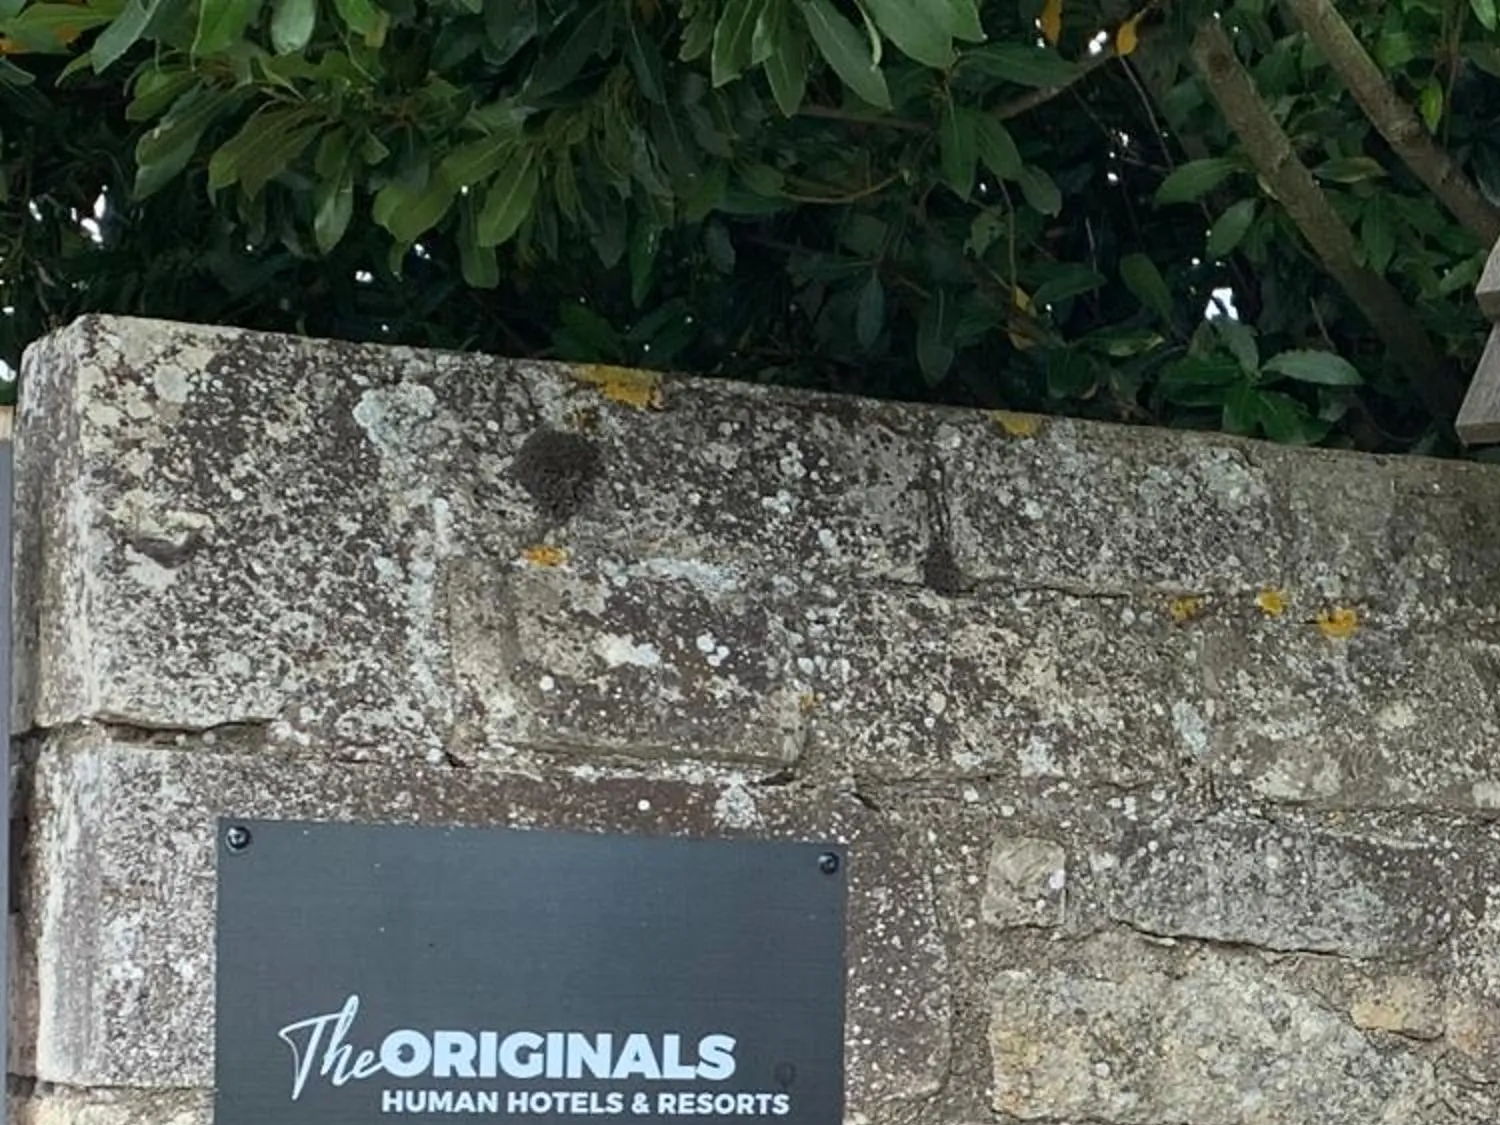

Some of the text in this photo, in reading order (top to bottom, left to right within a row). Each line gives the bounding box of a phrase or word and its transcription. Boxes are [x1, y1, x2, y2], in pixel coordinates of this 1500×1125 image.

[278, 995, 738, 1100] The ORIGINALS
[382, 1090, 790, 1115] HUMAN HOTELS & RESORTS
